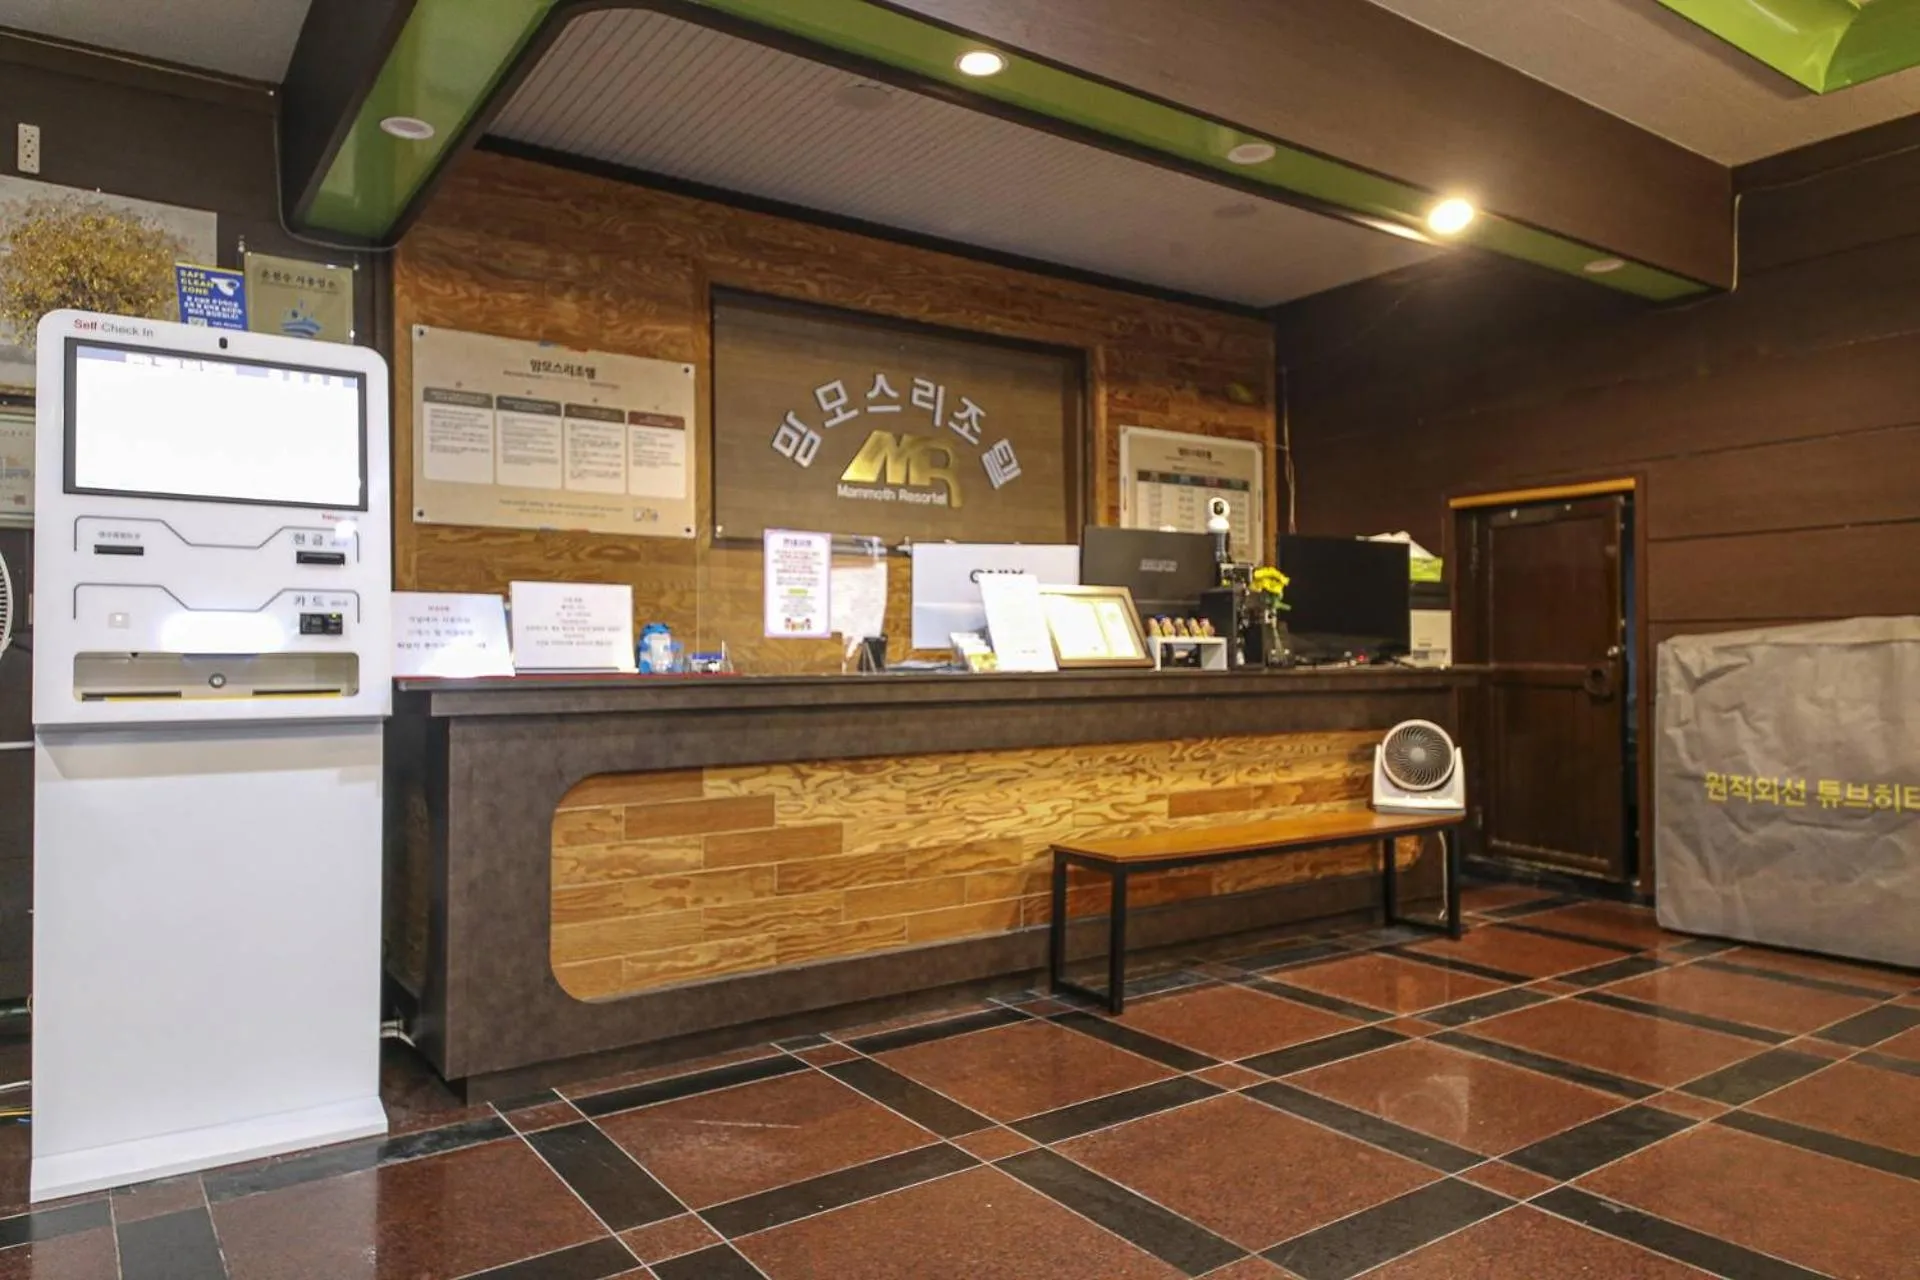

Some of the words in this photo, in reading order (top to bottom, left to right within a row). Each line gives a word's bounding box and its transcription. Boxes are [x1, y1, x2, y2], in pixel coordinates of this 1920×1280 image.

[180, 269, 206, 280] SAFE
[181, 277, 214, 289] CLEAN
[181, 285, 209, 296] ZONE
[73, 318, 98, 332] Self
[101, 321, 139, 336] Check
[142, 327, 154, 338] In
[772, 373, 1022, 490] 맘모스리조텔
[836, 483, 897, 502] Mammoth
[898, 488, 949, 507] Resortel
[1705, 771, 1808, 807] 원적외선
